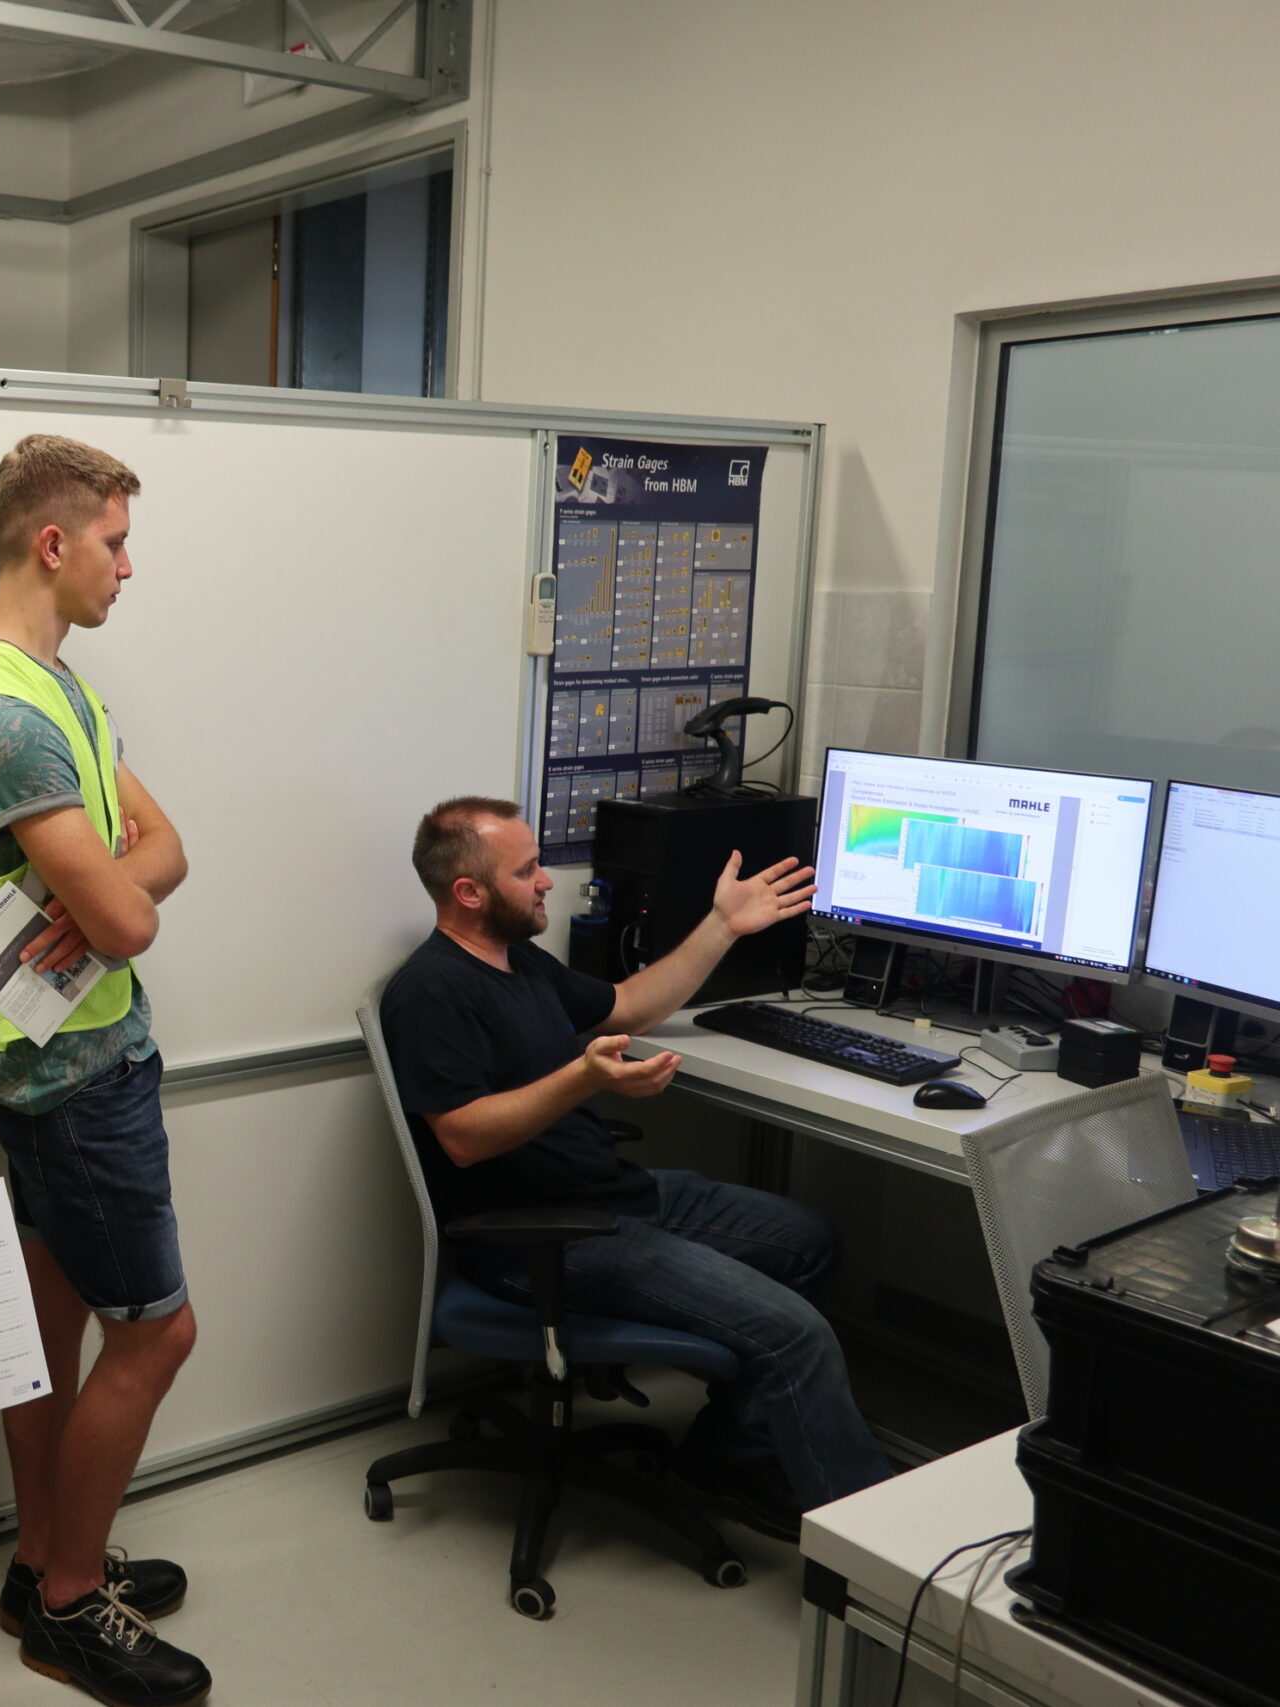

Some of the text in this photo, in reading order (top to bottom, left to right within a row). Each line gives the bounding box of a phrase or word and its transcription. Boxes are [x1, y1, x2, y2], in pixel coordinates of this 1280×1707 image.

[601, 453, 669, 473] Strain Gages
[644, 477, 697, 493] from HBM
[728, 477, 748, 487] HBM
[1008, 798, 1051, 813] MAHLE
